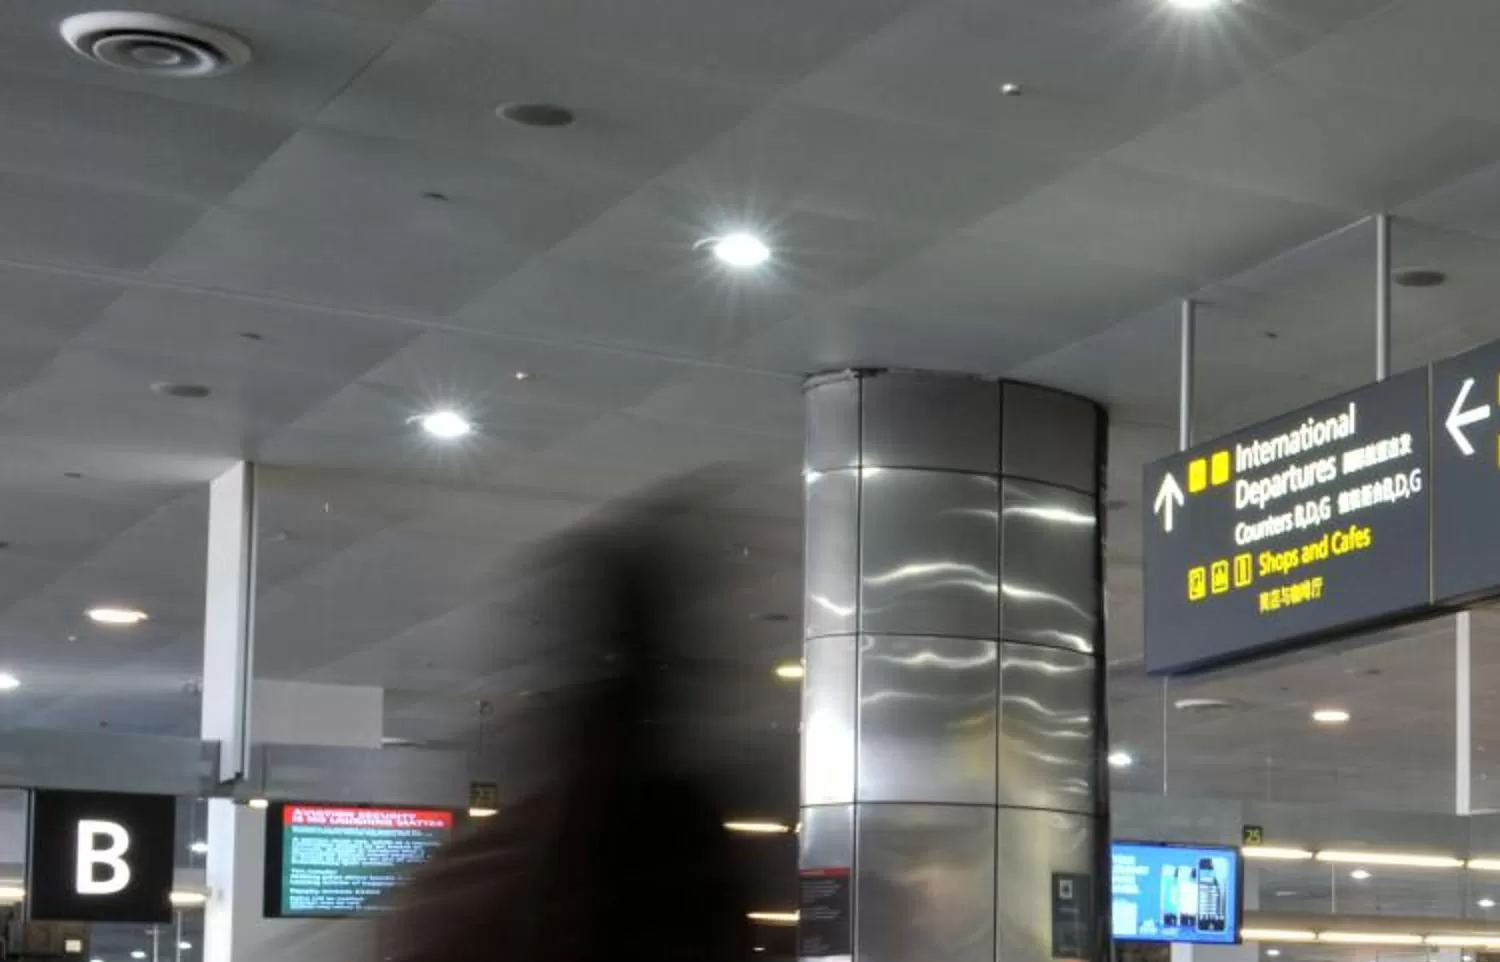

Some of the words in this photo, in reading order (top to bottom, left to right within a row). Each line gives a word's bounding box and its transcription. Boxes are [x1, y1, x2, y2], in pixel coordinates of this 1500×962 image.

[1234, 402, 1356, 474] International
[1234, 455, 1337, 510] Departures
[1234, 511, 1293, 546] Counters
[1259, 548, 1299, 577] Shops
[1301, 534, 1329, 564] and
[1331, 525, 1372, 555] Cafes
[76, 819, 131, 894] B
